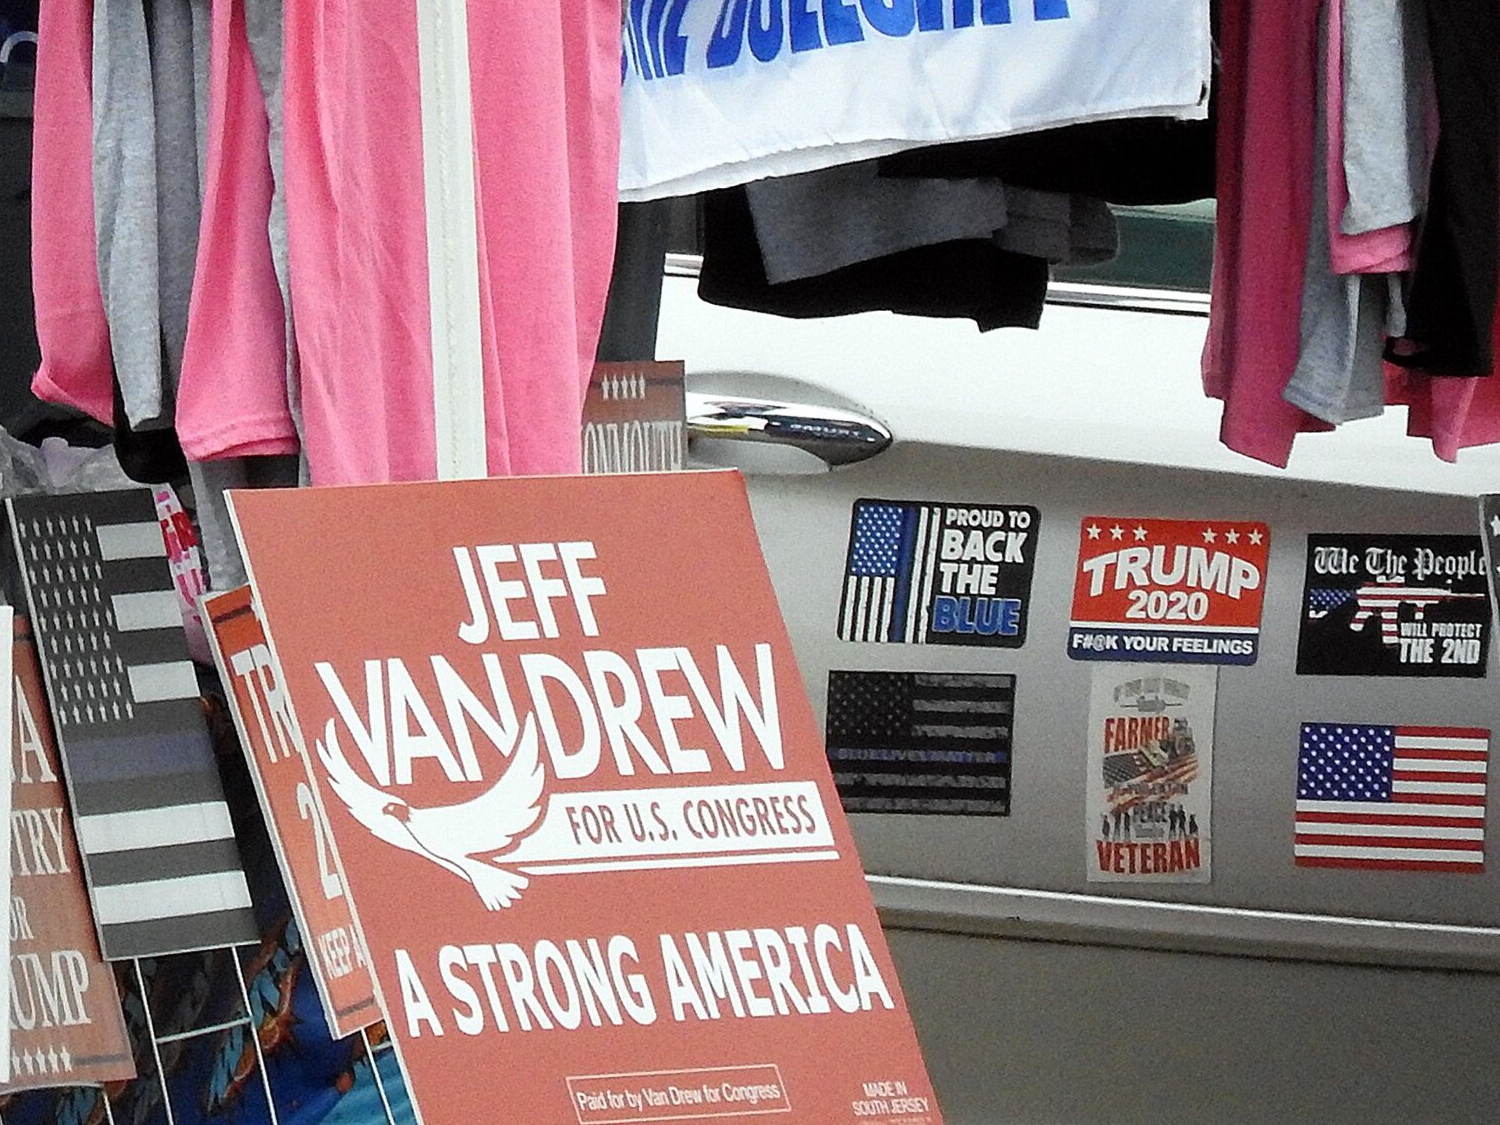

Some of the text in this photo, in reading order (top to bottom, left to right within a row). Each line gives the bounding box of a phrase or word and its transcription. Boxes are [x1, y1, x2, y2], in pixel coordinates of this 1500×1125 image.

[946, 508, 1031, 528] PROUD TO
[940, 528, 1028, 563] BACK
[939, 562, 1000, 595] THE
[1082, 544, 1261, 600] TRUMP
[1313, 546, 1488, 581] We The People
[451, 540, 608, 645] JEFF
[1125, 589, 1210, 621] 2020
[932, 594, 1022, 635] BLUE
[1400, 622, 1483, 638] WILL PROTECT
[1122, 636, 1169, 652] YOUR
[1171, 639, 1254, 655] FEELINGS
[1400, 638, 1481, 665] THE 2ND
[1103, 715, 1171, 753] FARMER
[566, 794, 818, 845] FOR U.S. CONGRESS
[10, 807, 71, 877] TRY
[1095, 839, 1200, 876] VETERAN
[10, 949, 92, 1031] UMP
[394, 923, 896, 1038] A STRONG AMERICA
[576, 1083, 781, 1112] Paid for by Van Drew for Congress
[852, 1097, 929, 1116] SOUTH JERSEY
